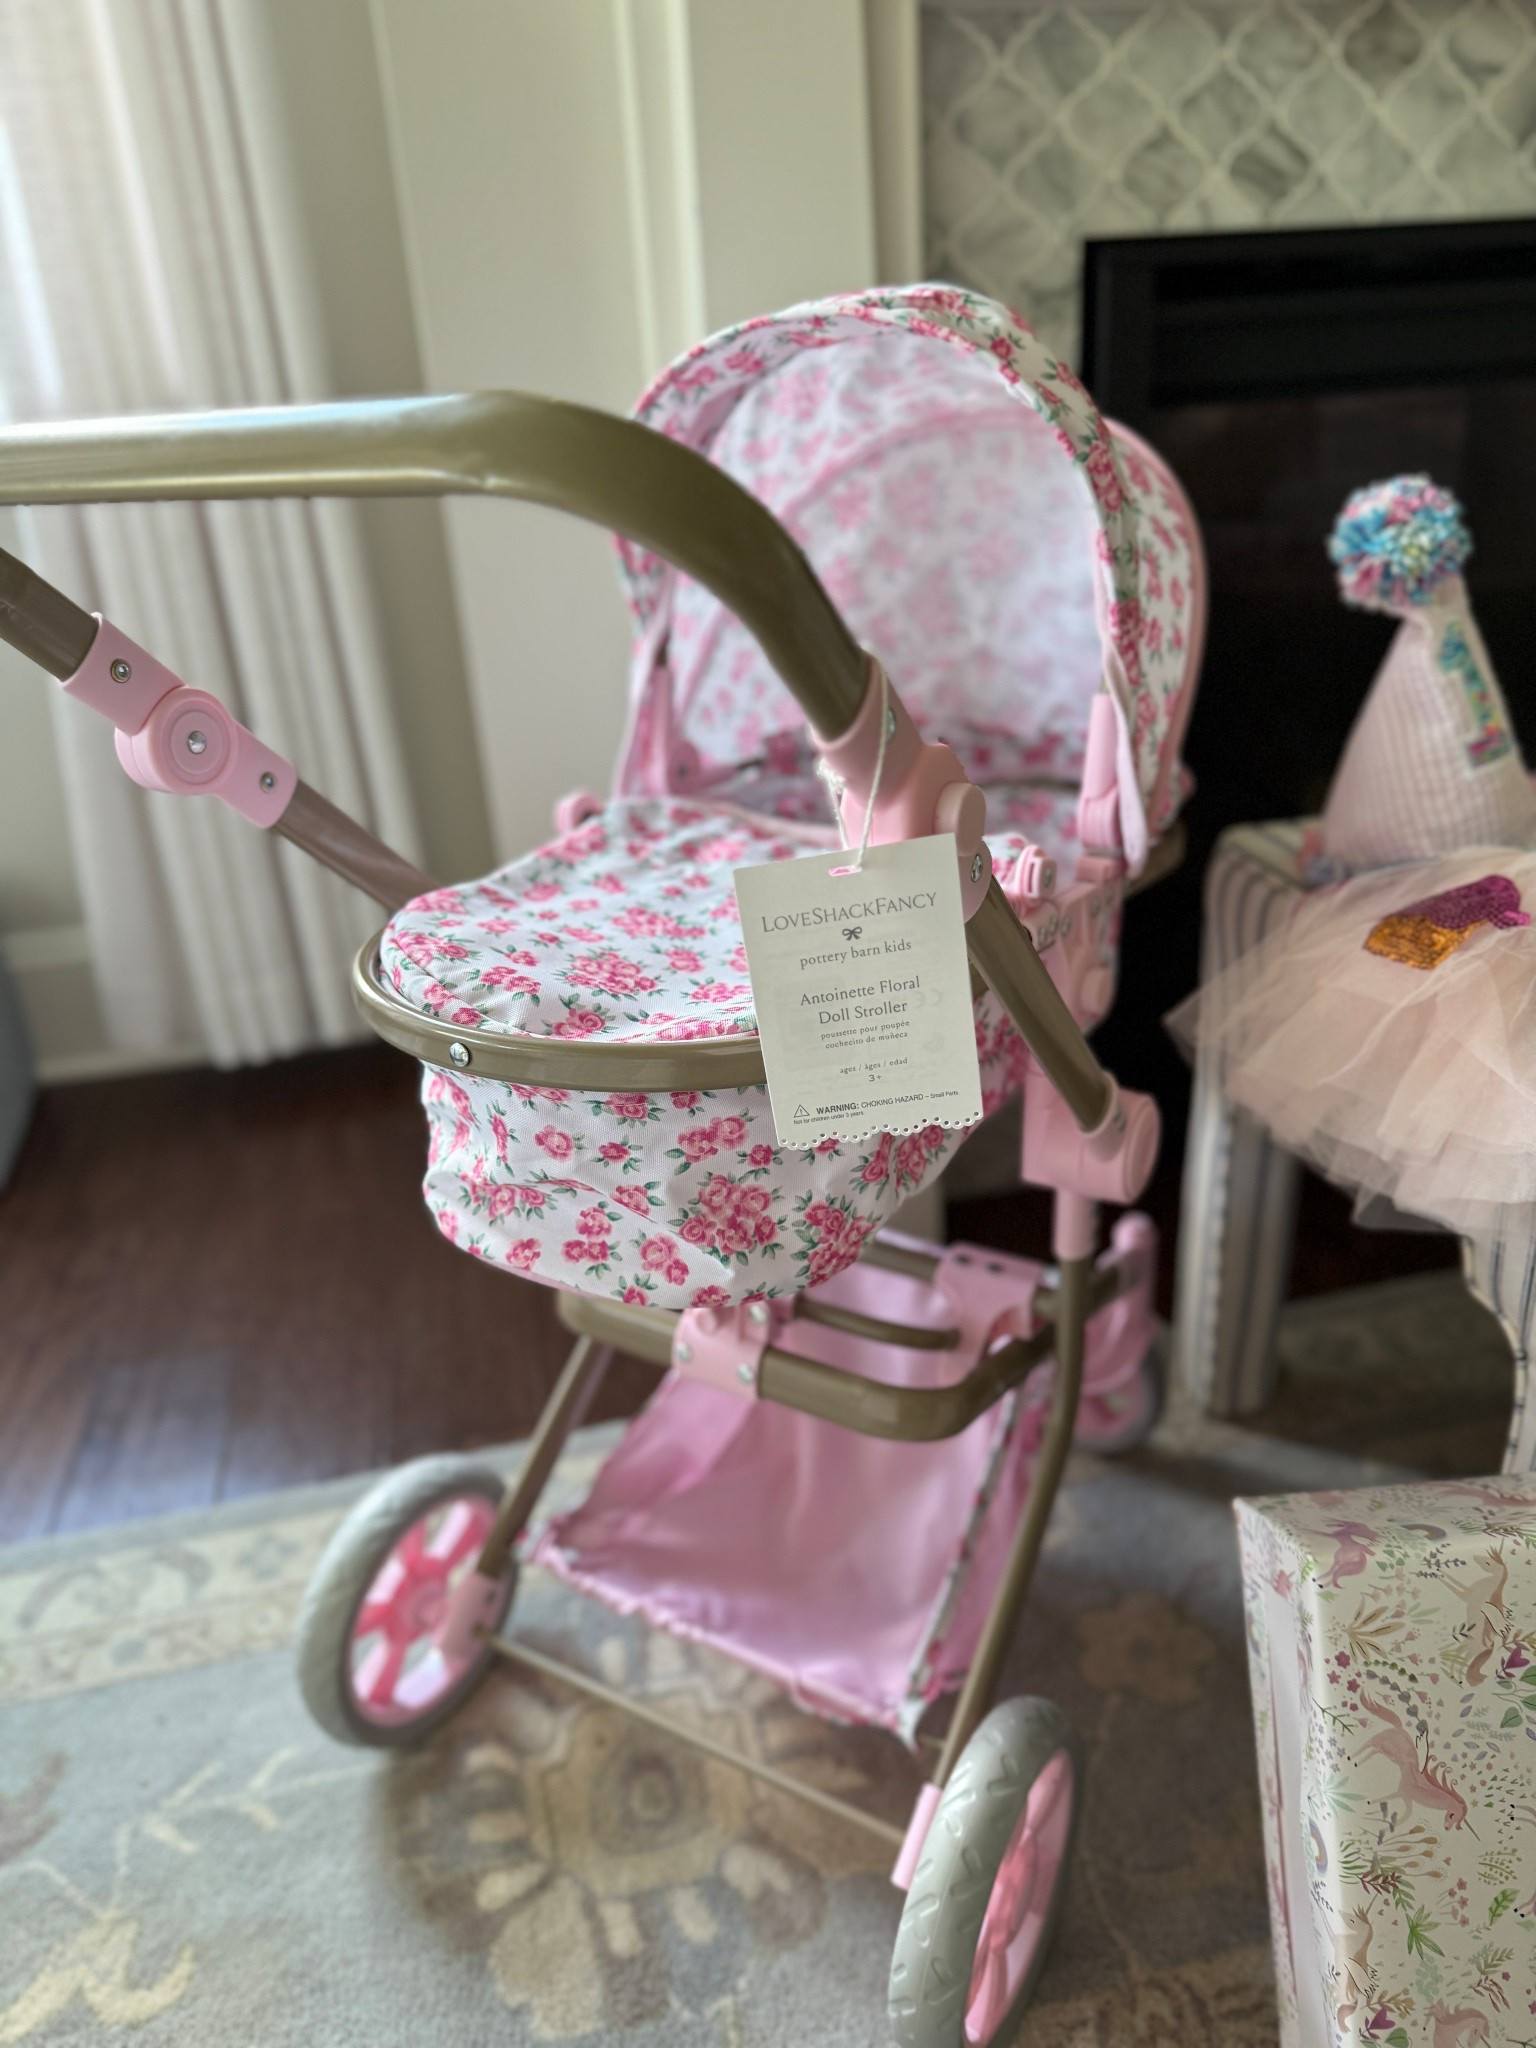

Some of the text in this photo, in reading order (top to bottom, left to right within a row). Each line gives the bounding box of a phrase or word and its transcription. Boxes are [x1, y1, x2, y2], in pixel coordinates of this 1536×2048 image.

[800, 938, 912, 970] pottery barn kids
[800, 975, 921, 1006] Antoinette Floral
[819, 1001, 908, 1024] Doll Stroller
[820, 1019, 910, 1041] poussette pour poupée
[825, 1031, 908, 1049] cochecito de muñeca
[839, 1066, 857, 1075] ages
[889, 1057, 908, 1066] edad
[816, 1102, 860, 1114] WARNING:
[861, 1098, 894, 1109] CHOKING
[894, 1093, 924, 1104] HAZARD
